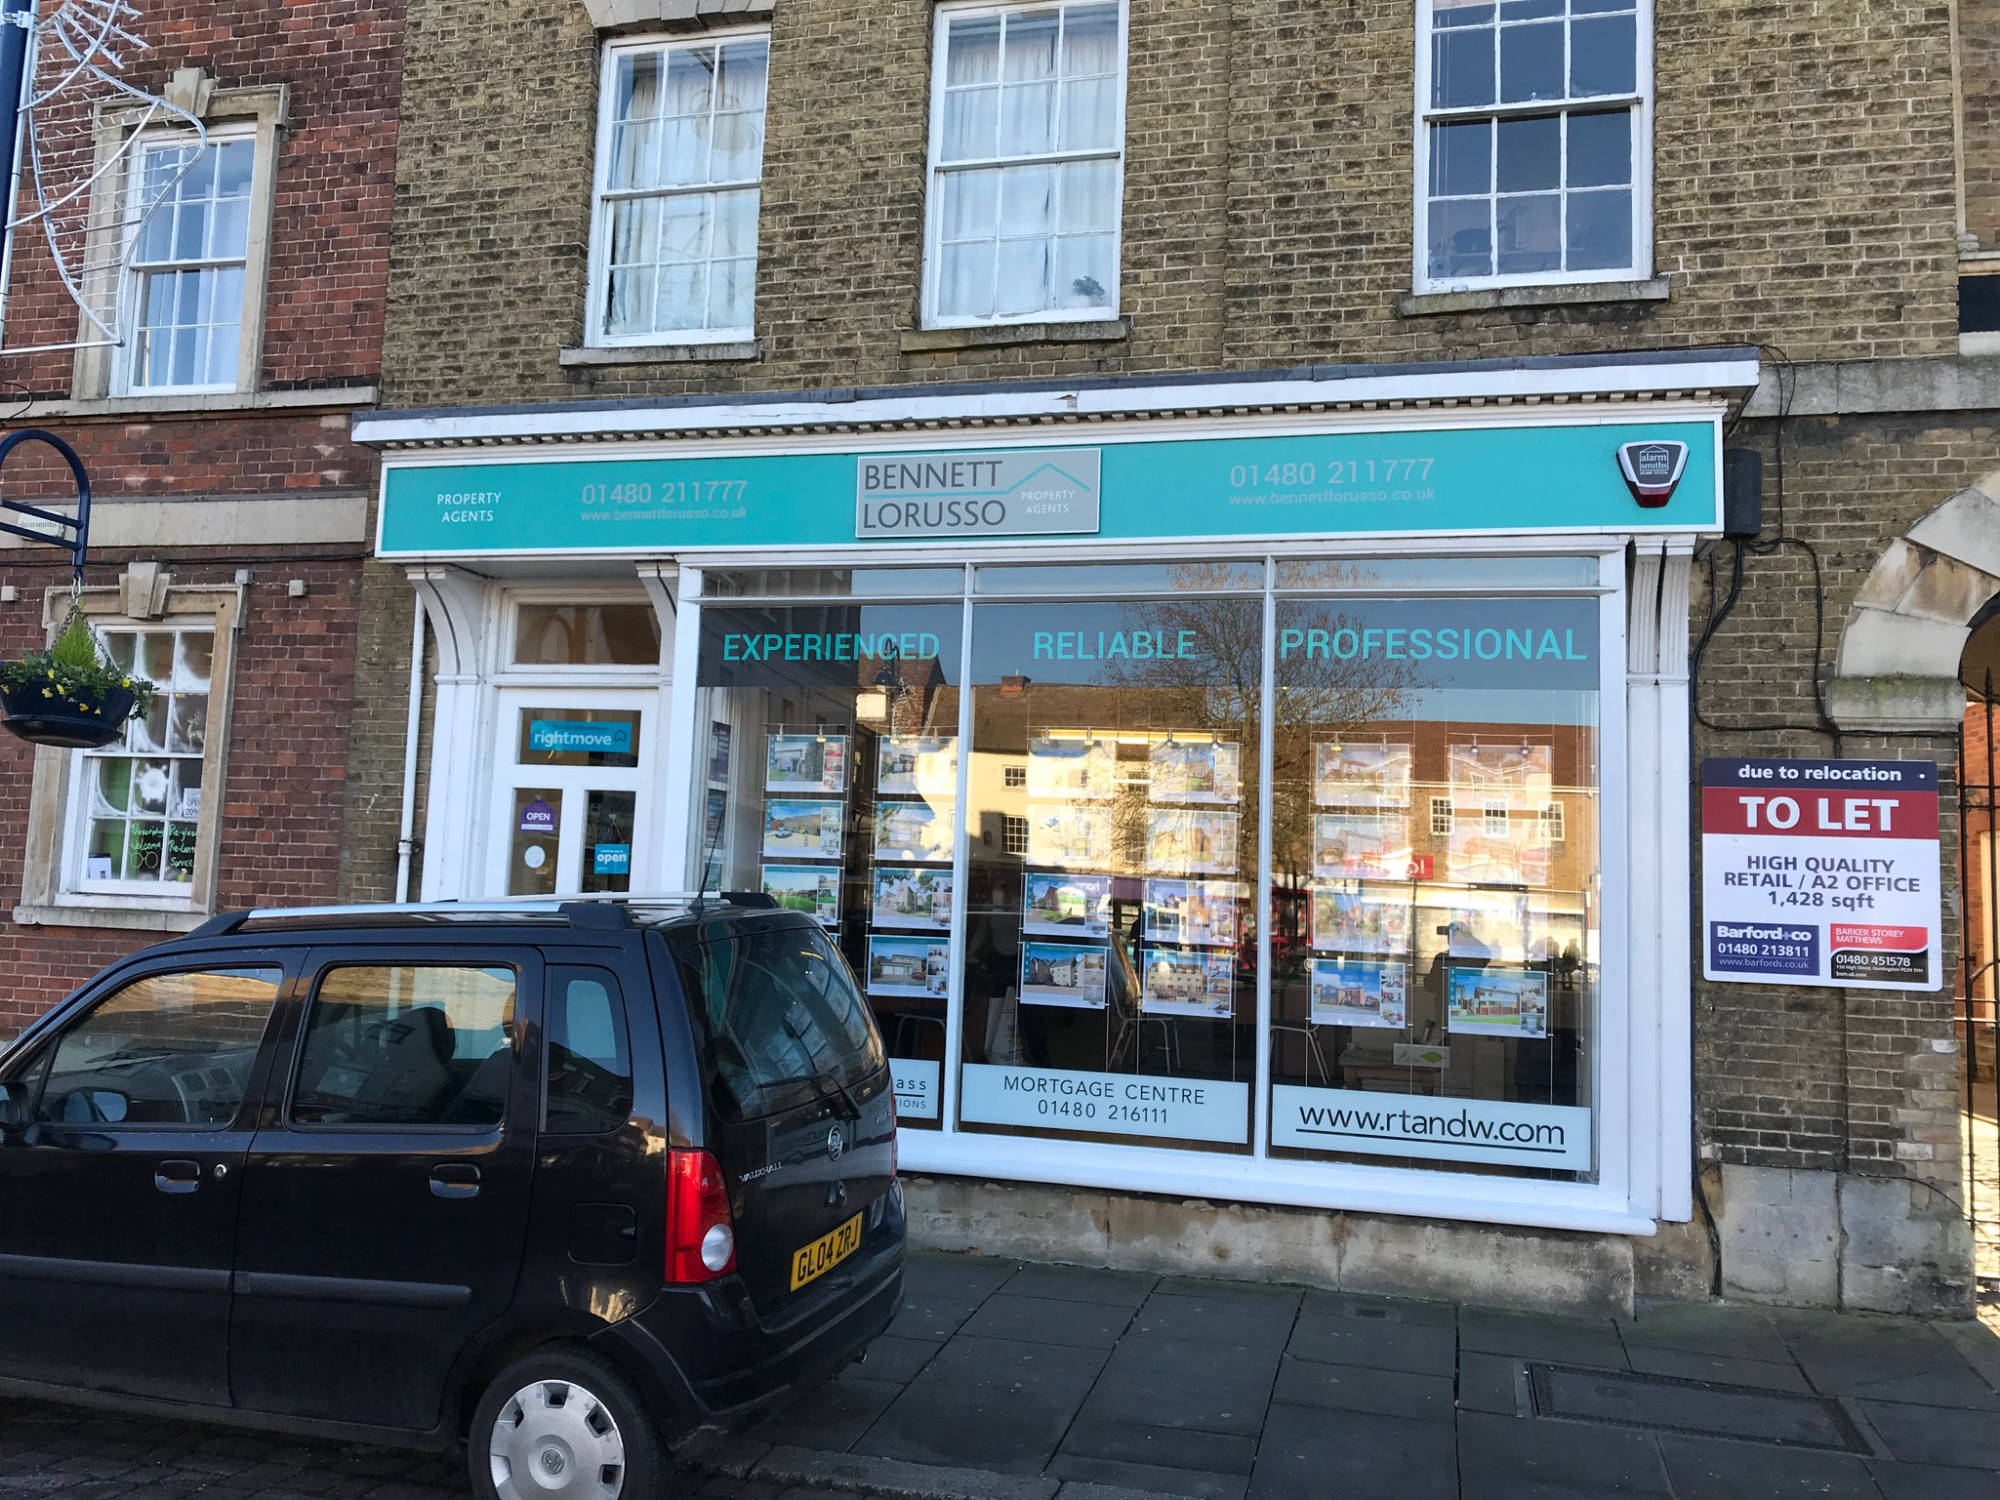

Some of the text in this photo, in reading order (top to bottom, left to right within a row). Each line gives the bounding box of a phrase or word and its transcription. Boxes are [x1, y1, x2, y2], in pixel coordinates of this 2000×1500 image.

[1641, 453, 1667, 461] alarm
[1229, 458, 1435, 488] 01480 211777
[1641, 462, 1667, 470] smiths
[864, 461, 1003, 490] BENNETT
[436, 492, 502, 507] PROPERTY
[581, 480, 748, 506] 01480 211777
[1020, 489, 1076, 503] PROPERTY
[1228, 489, 1435, 506] www.bennettlorusso.co.uk
[441, 510, 494, 522] AGENTS
[580, 506, 748, 521] www.bennettlorusso.co.uk
[863, 500, 1007, 530] LORUSSO
[1025, 503, 1069, 515] AGENTS
[723, 633, 939, 661] EXPERIENCED
[1033, 630, 1197, 660] RELIABLE
[1280, 627, 1587, 661] PROFESSIONAL
[534, 731, 611, 747] rightmove
[1738, 765, 1902, 781] due to relocation
[526, 812, 550, 821] OPEN
[1739, 796, 1900, 832] TO LET
[597, 854, 627, 865] open
[1747, 856, 1895, 874] HIGH QUALITY
[1724, 872, 1920, 893] RETAIL / A2 OFFICE
[1768, 891, 1875, 911] 1,428 sqft
[1836, 928, 1904, 938] BARKER STOREY
[1836, 936, 1883, 945] MATTHEWS
[1718, 943, 1809, 957] 01480 213811
[1719, 959, 1809, 970] www.barfords.co.uk
[1836, 955, 1911, 967] 01480 451578
[1003, 1075, 1205, 1105] MORTGAGE CENTRE
[1038, 1099, 1168, 1124] 01480 216111
[1299, 1106, 1565, 1145] www.rtandw.com
[739, 1161, 783, 1183] VAUXHALL
[797, 1218, 860, 1282] GL04 ZRJ
